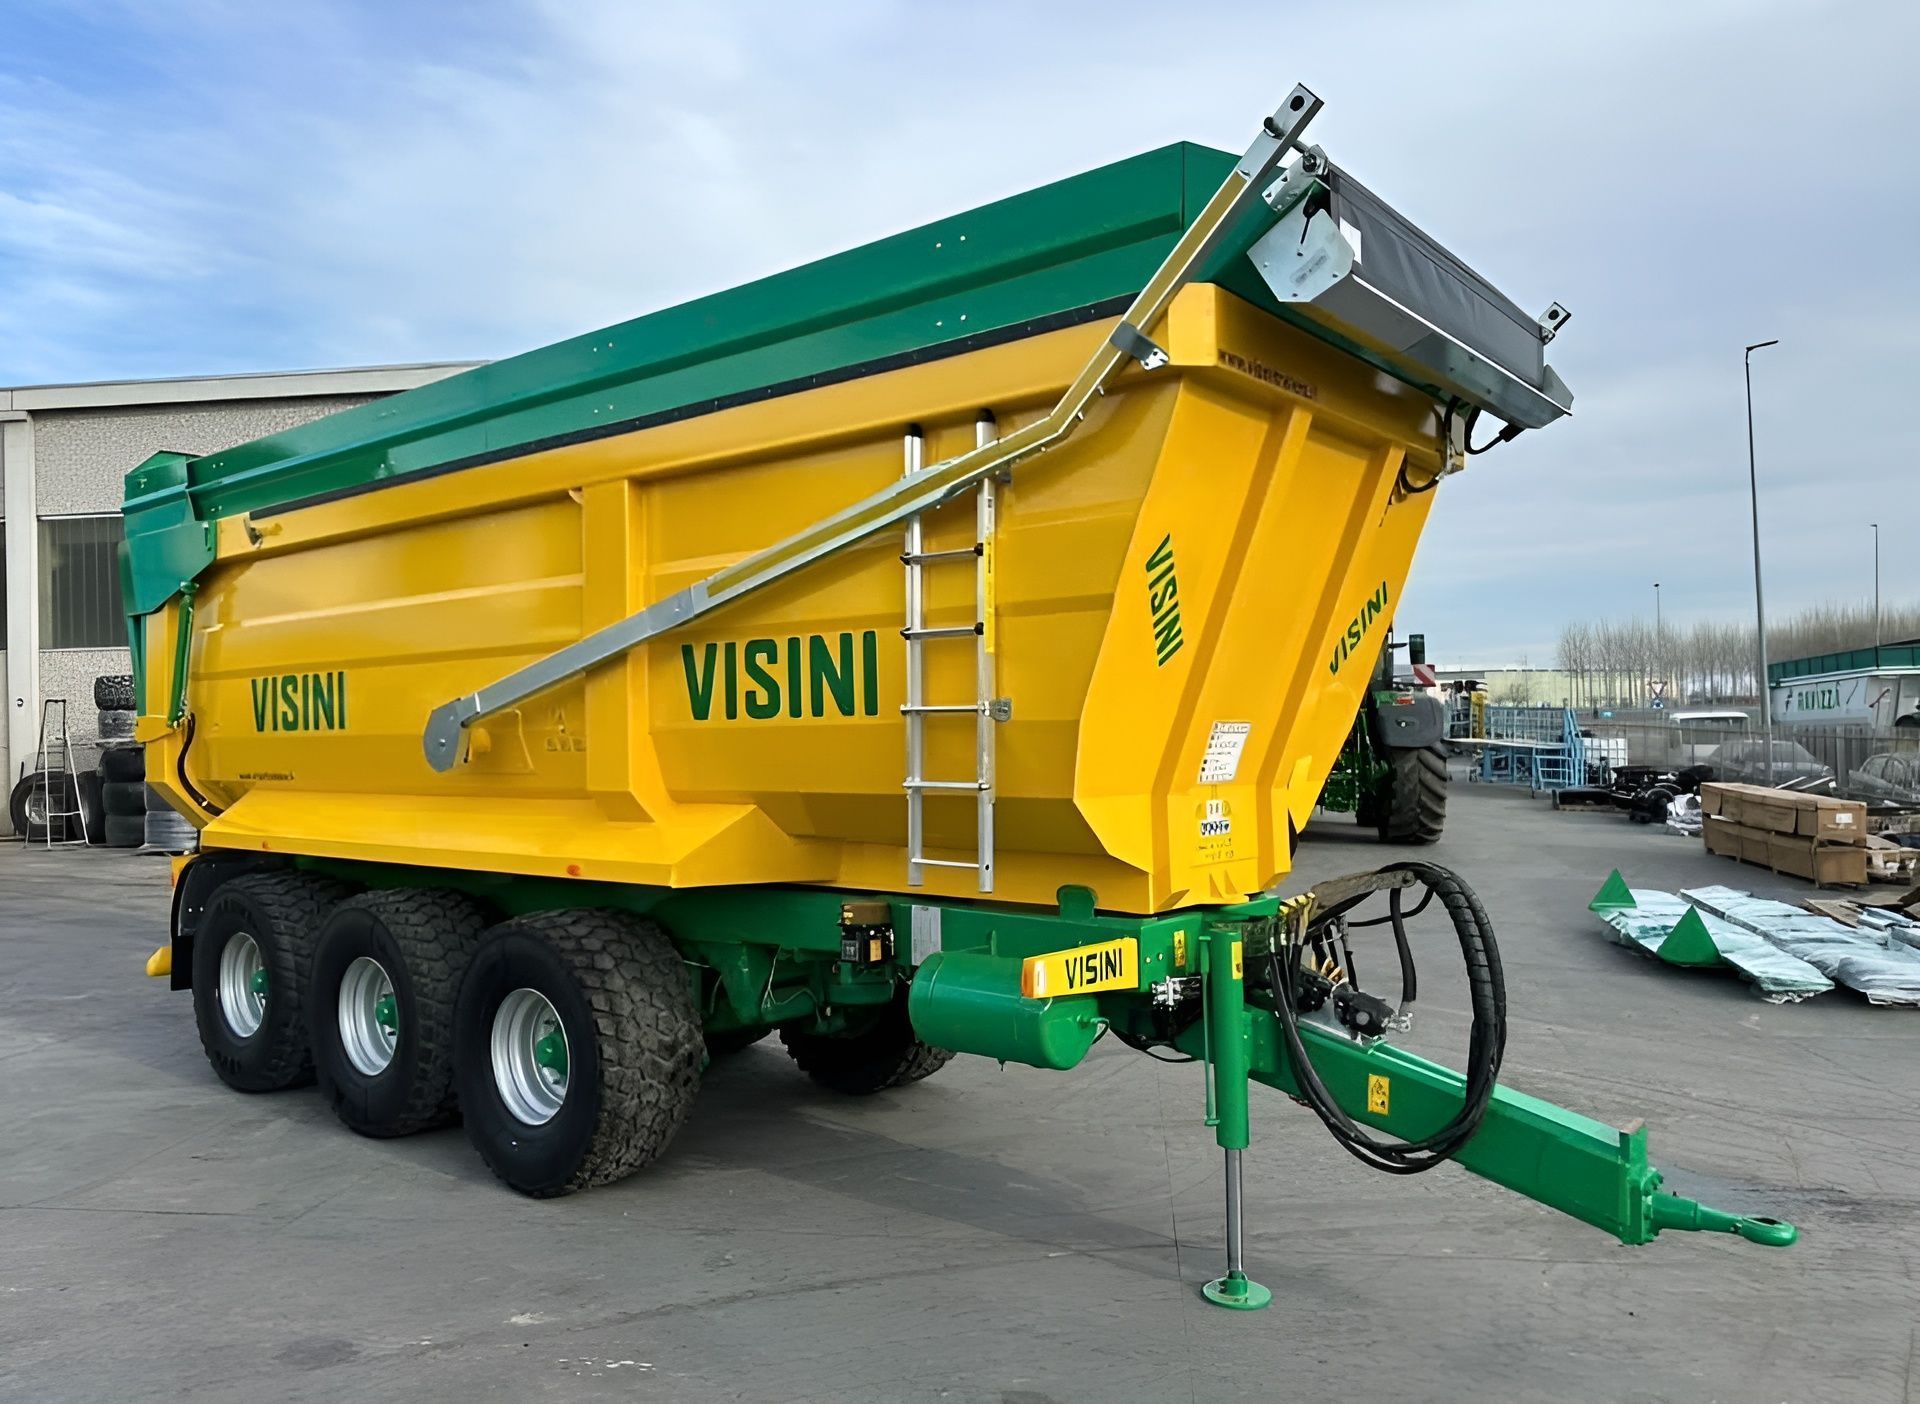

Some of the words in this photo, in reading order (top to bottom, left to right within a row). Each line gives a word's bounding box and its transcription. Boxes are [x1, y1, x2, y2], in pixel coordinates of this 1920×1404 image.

[1145, 533, 1184, 667] VISINI
[1329, 580, 1388, 676] VISINI
[252, 671, 346, 733] VISINI
[681, 630, 879, 721] VISINI
[1065, 947, 1123, 990] VISINI
